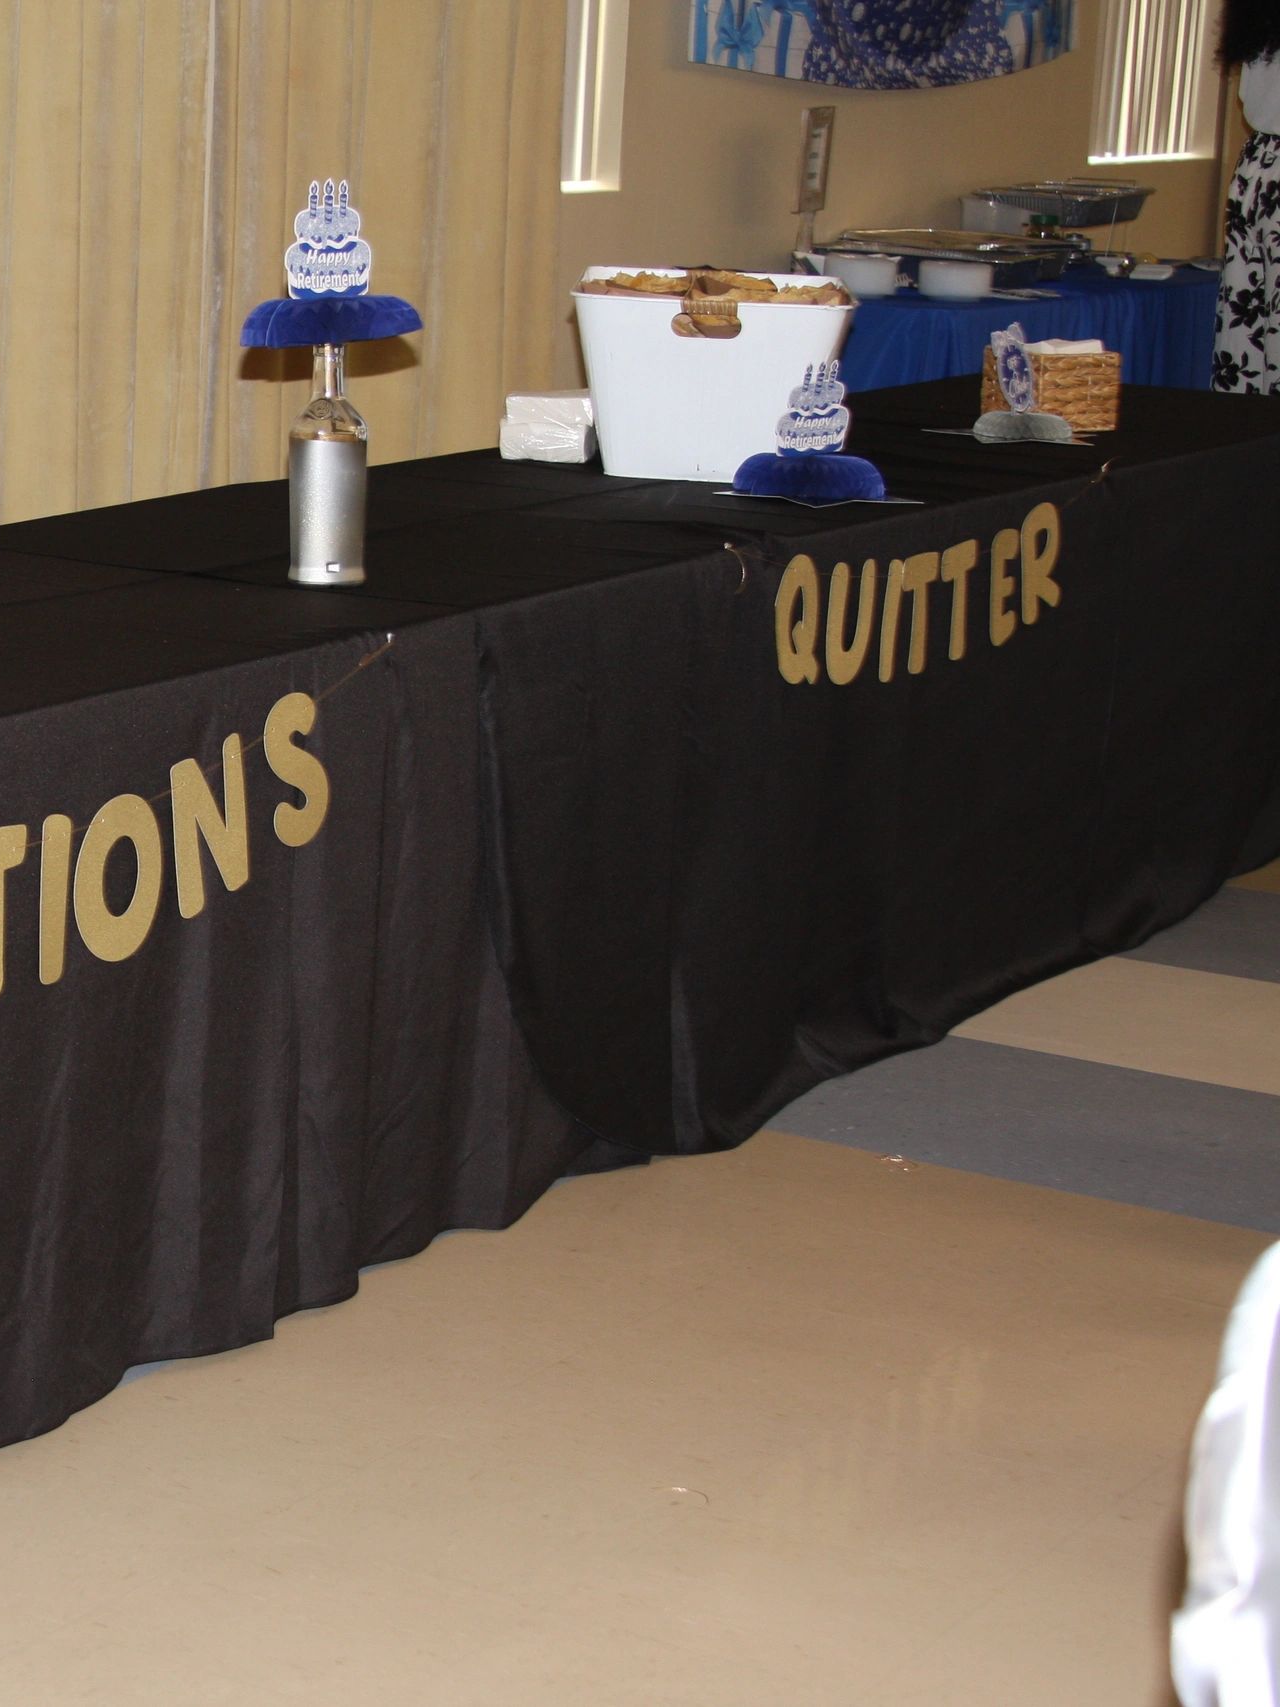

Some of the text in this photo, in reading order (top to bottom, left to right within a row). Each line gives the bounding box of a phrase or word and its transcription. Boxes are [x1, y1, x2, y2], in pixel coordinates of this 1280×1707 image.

[306, 249, 351, 266] Happy
[297, 271, 361, 289] Retirement
[794, 416, 833, 430] Happy
[784, 431, 838, 449] Retirement
[775, 502, 1062, 685] QUITTER
